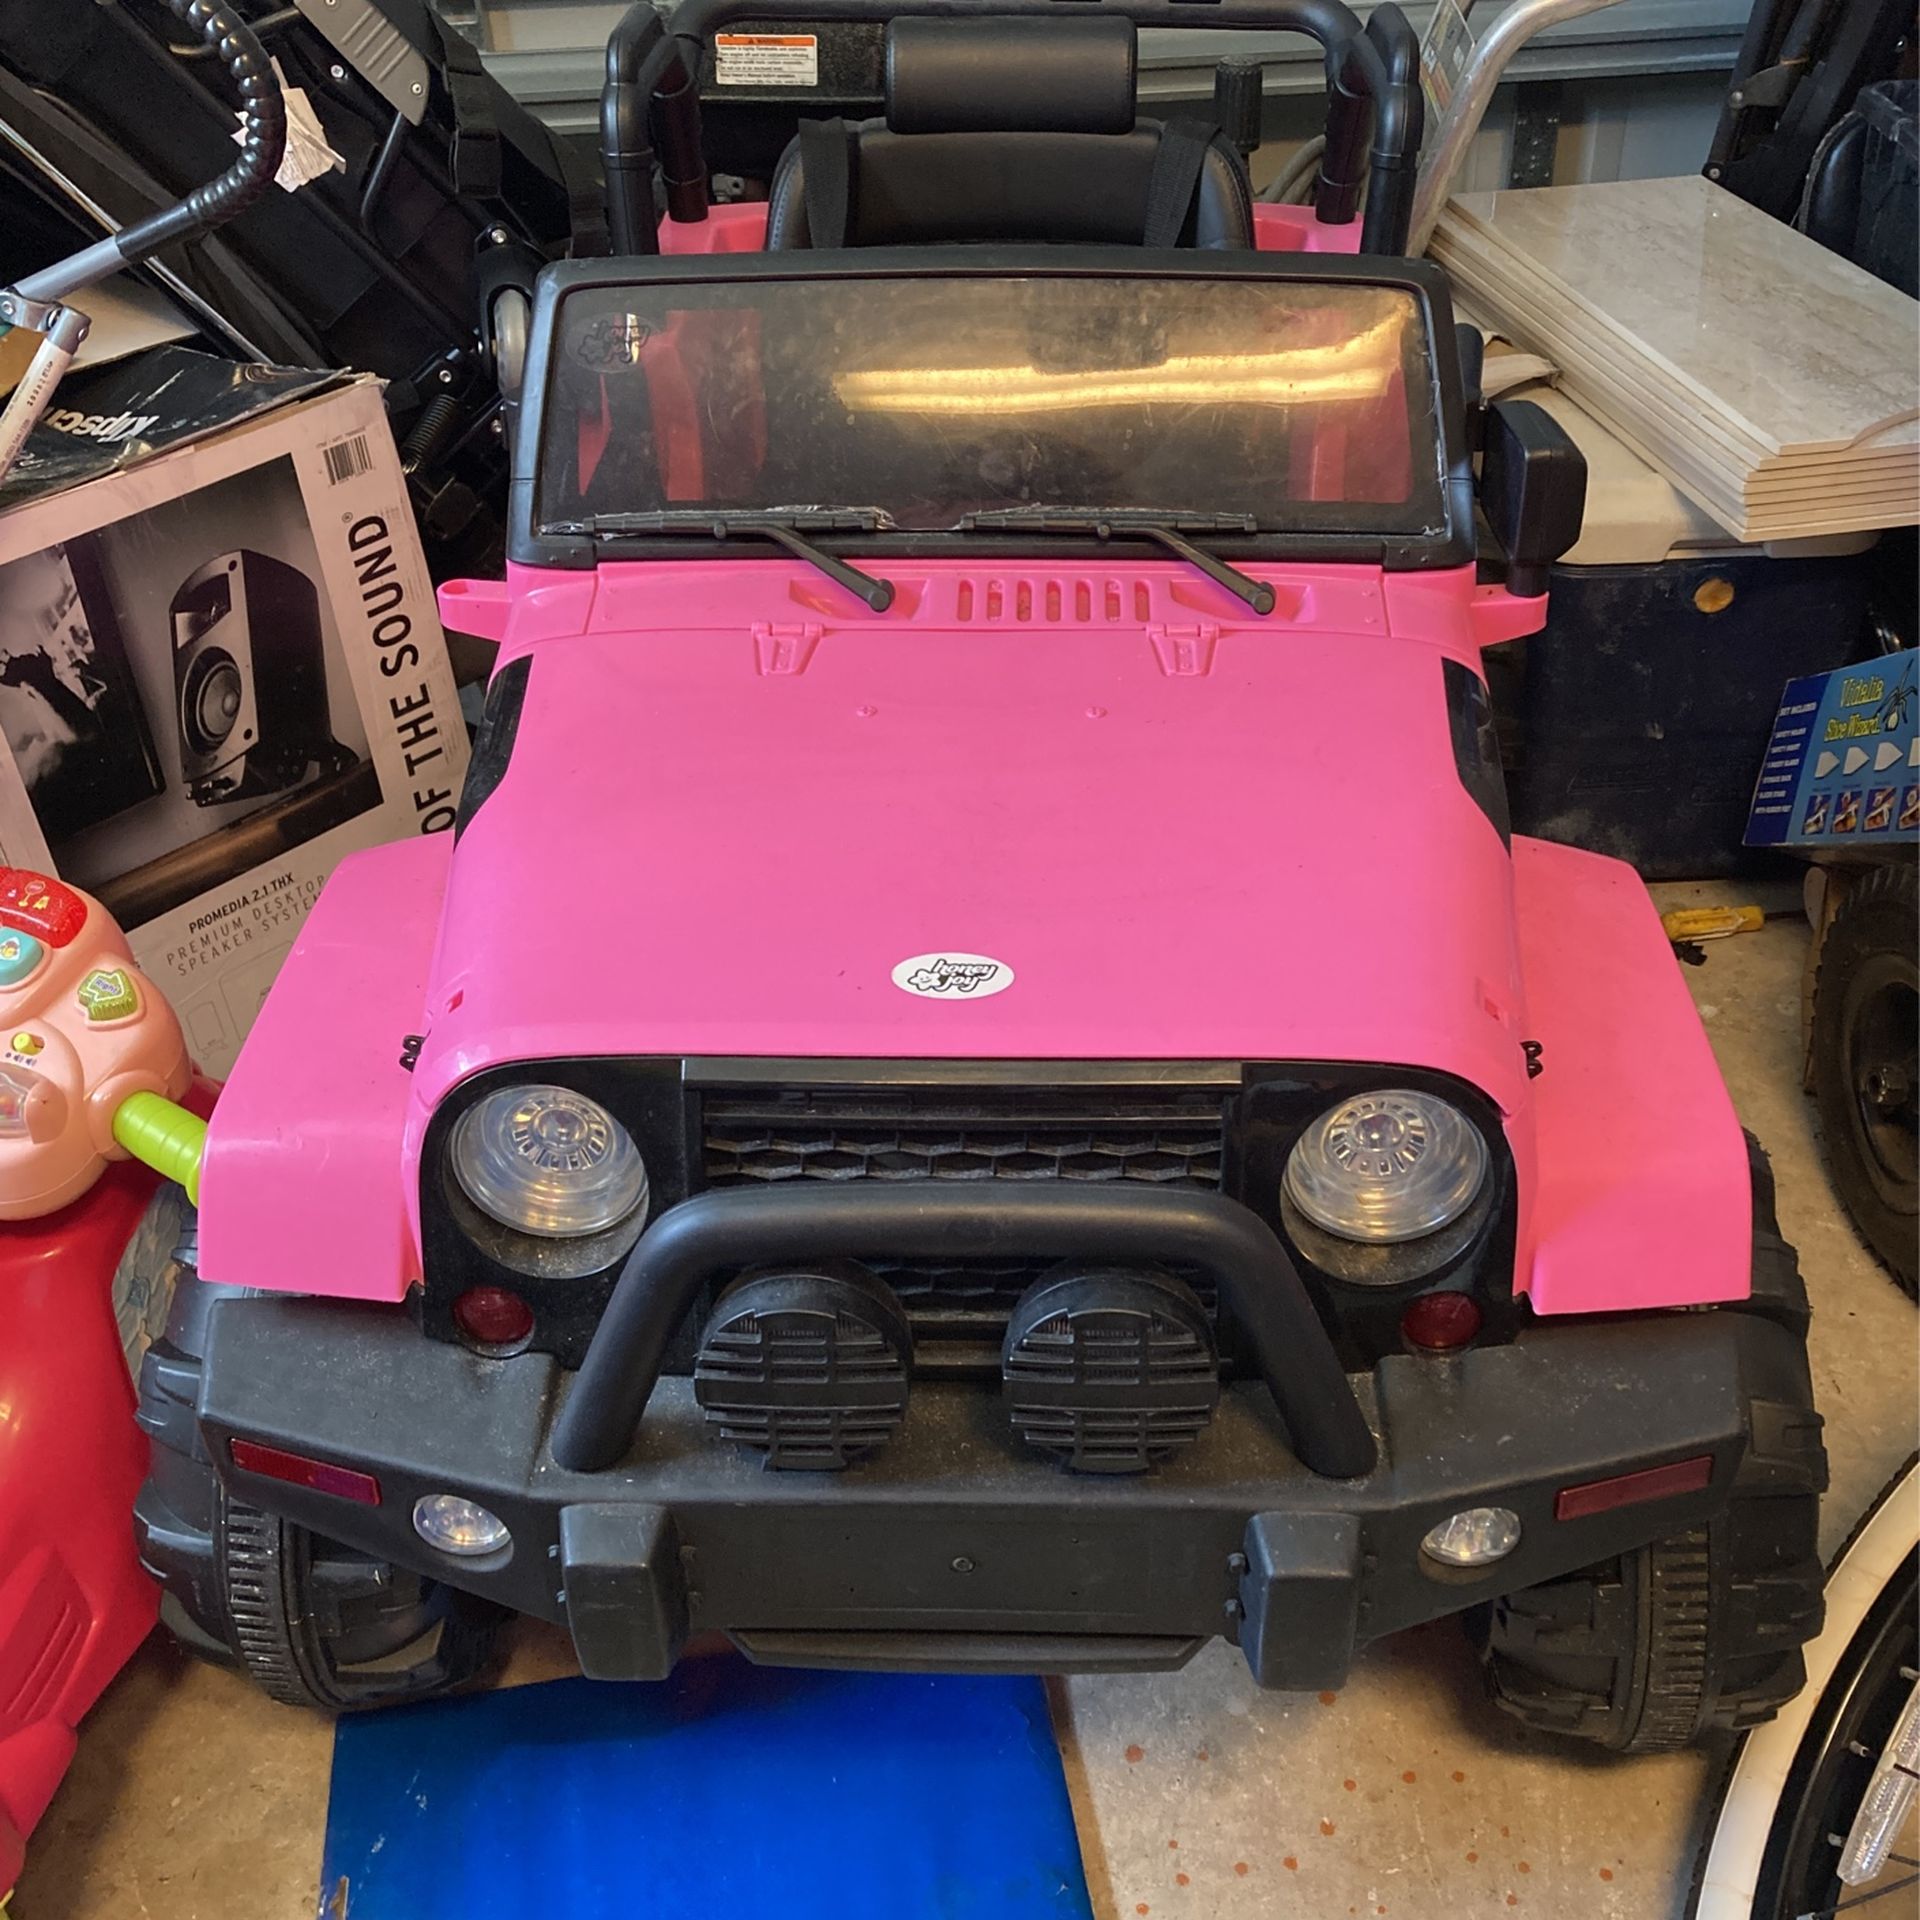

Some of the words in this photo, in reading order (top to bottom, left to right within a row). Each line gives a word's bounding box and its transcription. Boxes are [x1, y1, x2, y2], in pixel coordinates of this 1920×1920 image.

[348, 515, 419, 677] SOUND
[390, 683, 443, 777] THE
[413, 788, 456, 835] OF
[166, 917, 244, 966] PREMIUM
[252, 875, 325, 921] DESKTOP
[188, 895, 250, 934] PROMEDIA
[251, 885, 269, 902] 2.1
[270, 872, 295, 892] THX
[177, 928, 253, 977] SPEAKER
[931, 958, 999, 981] honey
